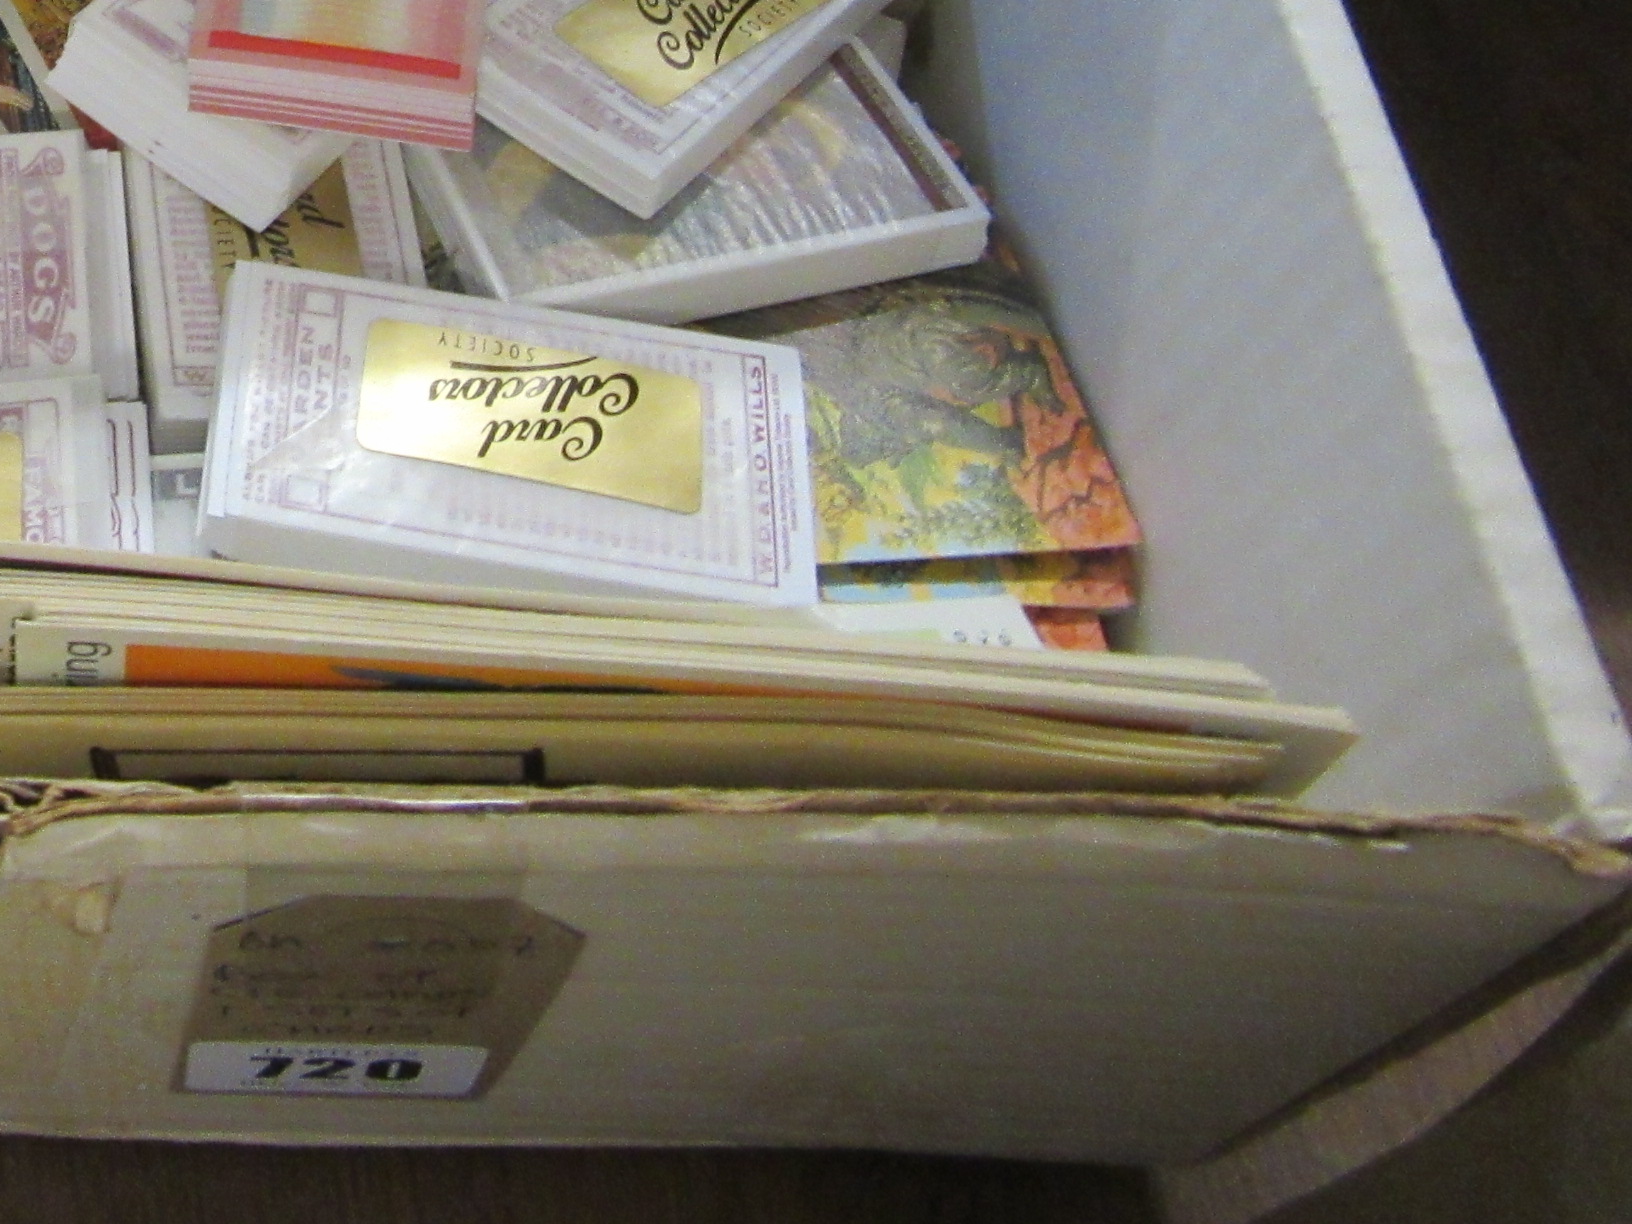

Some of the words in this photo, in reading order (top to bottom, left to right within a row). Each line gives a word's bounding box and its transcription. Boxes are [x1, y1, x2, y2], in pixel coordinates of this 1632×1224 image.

[24, 184, 61, 326] DOGS
[437, 332, 537, 362] SOCIETY
[428, 373, 640, 416] Collectors
[746, 364, 765, 443] WILLS
[477, 416, 603, 461] Card
[250, 1056, 423, 1082] 720
